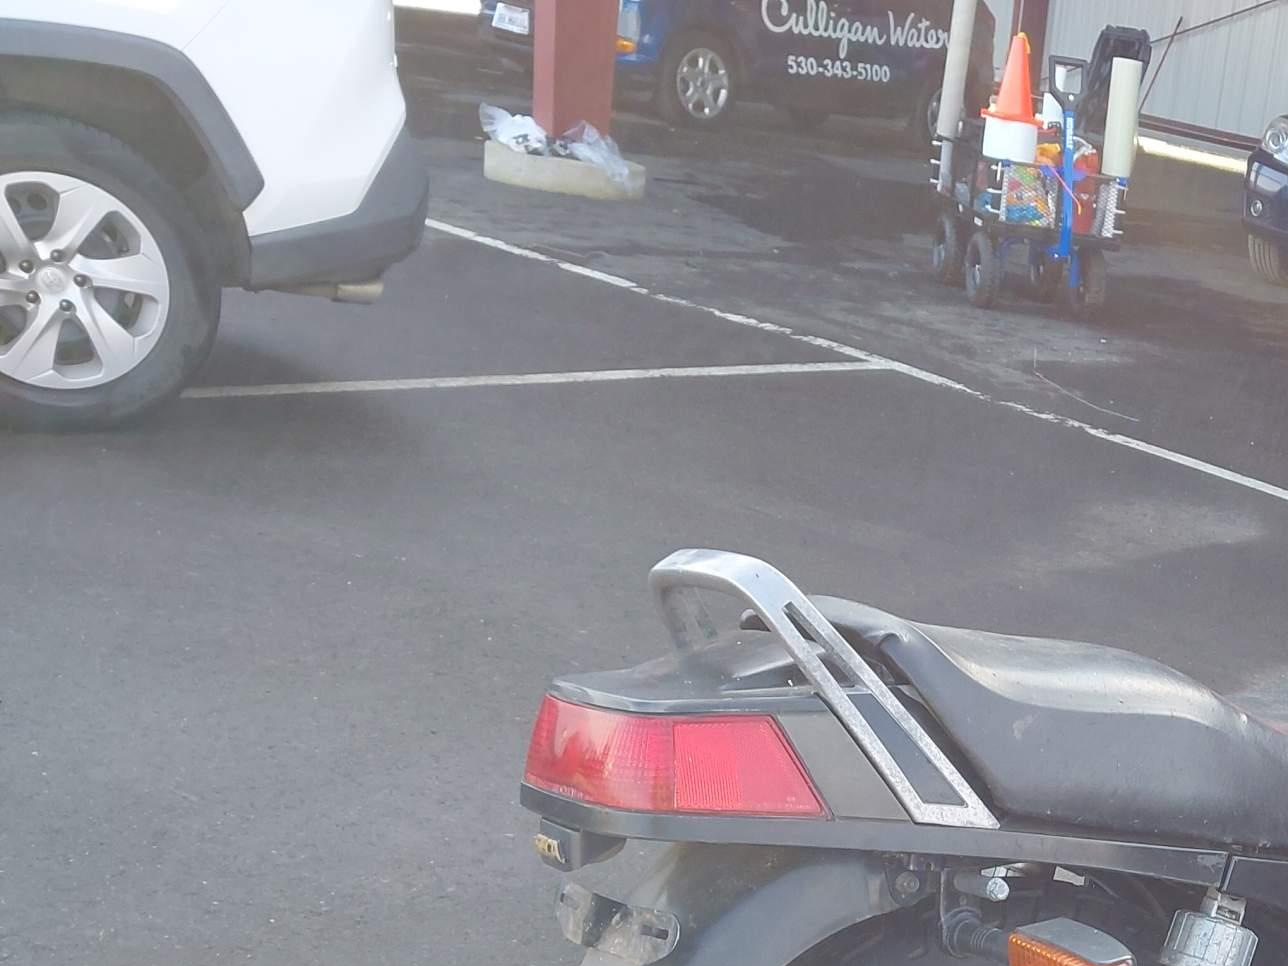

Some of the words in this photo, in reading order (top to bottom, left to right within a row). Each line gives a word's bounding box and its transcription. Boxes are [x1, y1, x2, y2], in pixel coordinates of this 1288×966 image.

[761, 0, 886, 59] Culligan
[888, 10, 950, 49] Water
[787, 55, 890, 82] 530-343-5100
